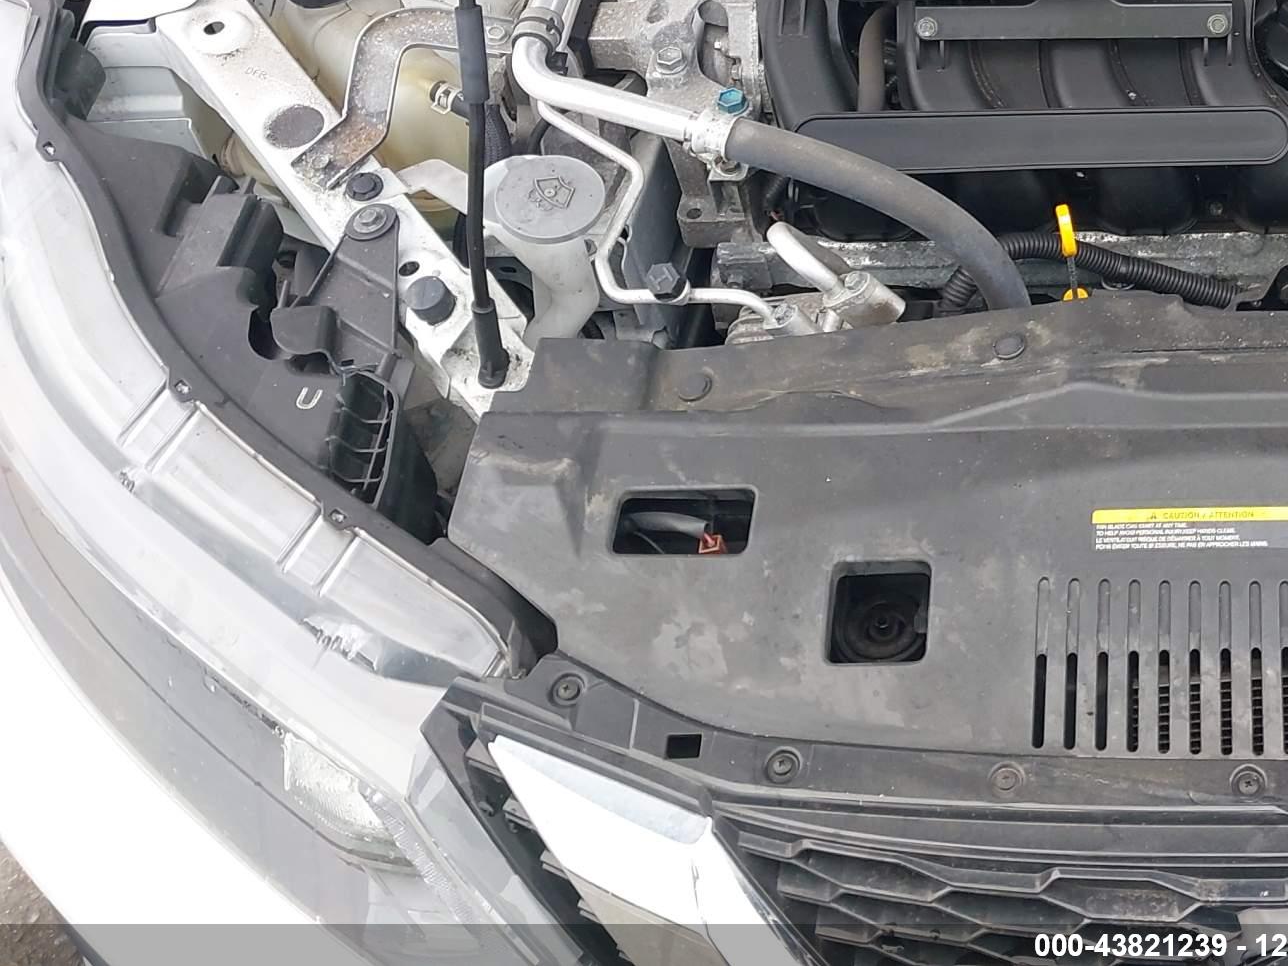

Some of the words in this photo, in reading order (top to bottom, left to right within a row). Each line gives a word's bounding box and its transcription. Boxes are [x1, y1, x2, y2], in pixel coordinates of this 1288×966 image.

[296, 387, 323, 409] U
[1163, 512, 1199, 520] CAUTION
[1209, 511, 1254, 519] ATTENTION
